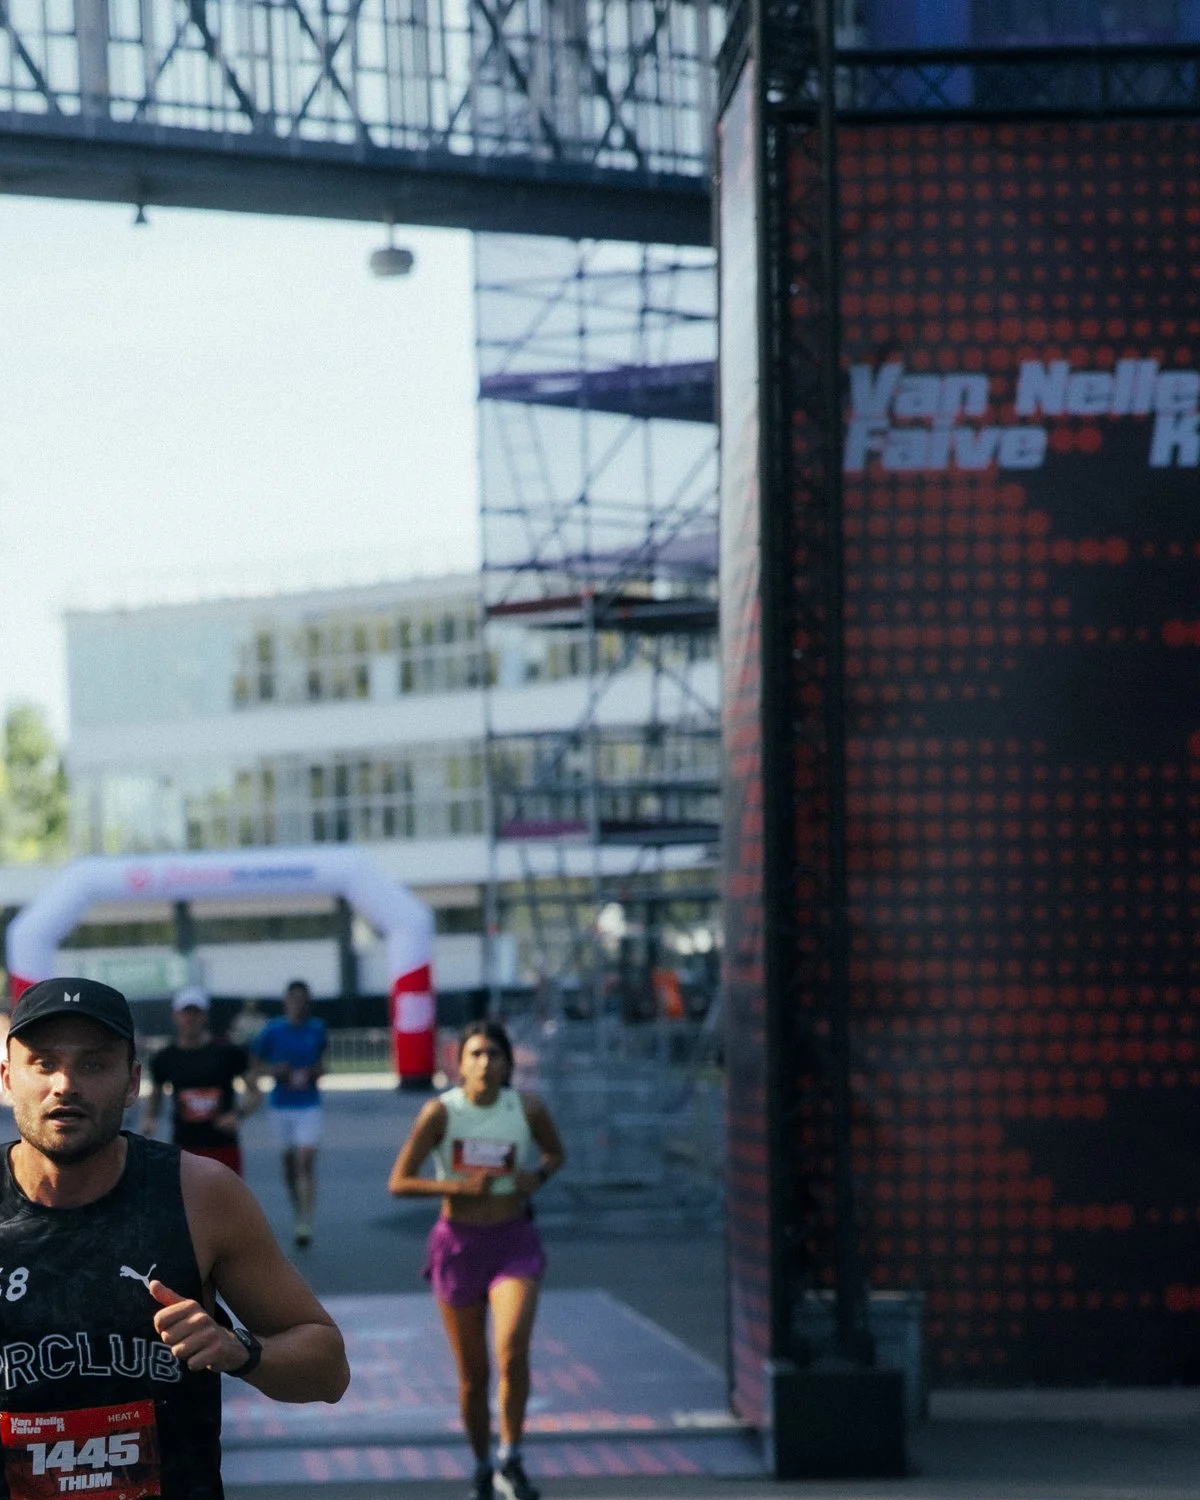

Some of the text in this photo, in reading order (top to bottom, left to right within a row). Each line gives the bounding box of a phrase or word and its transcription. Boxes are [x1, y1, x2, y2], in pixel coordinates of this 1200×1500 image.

[849, 358, 1199, 416] Van Nelle
[844, 416, 1048, 471] Faive
[10, 1416, 64, 1426] Van Nelle
[108, 1410, 140, 1423] HEAT 4
[27, 1432, 140, 1476] 1445
